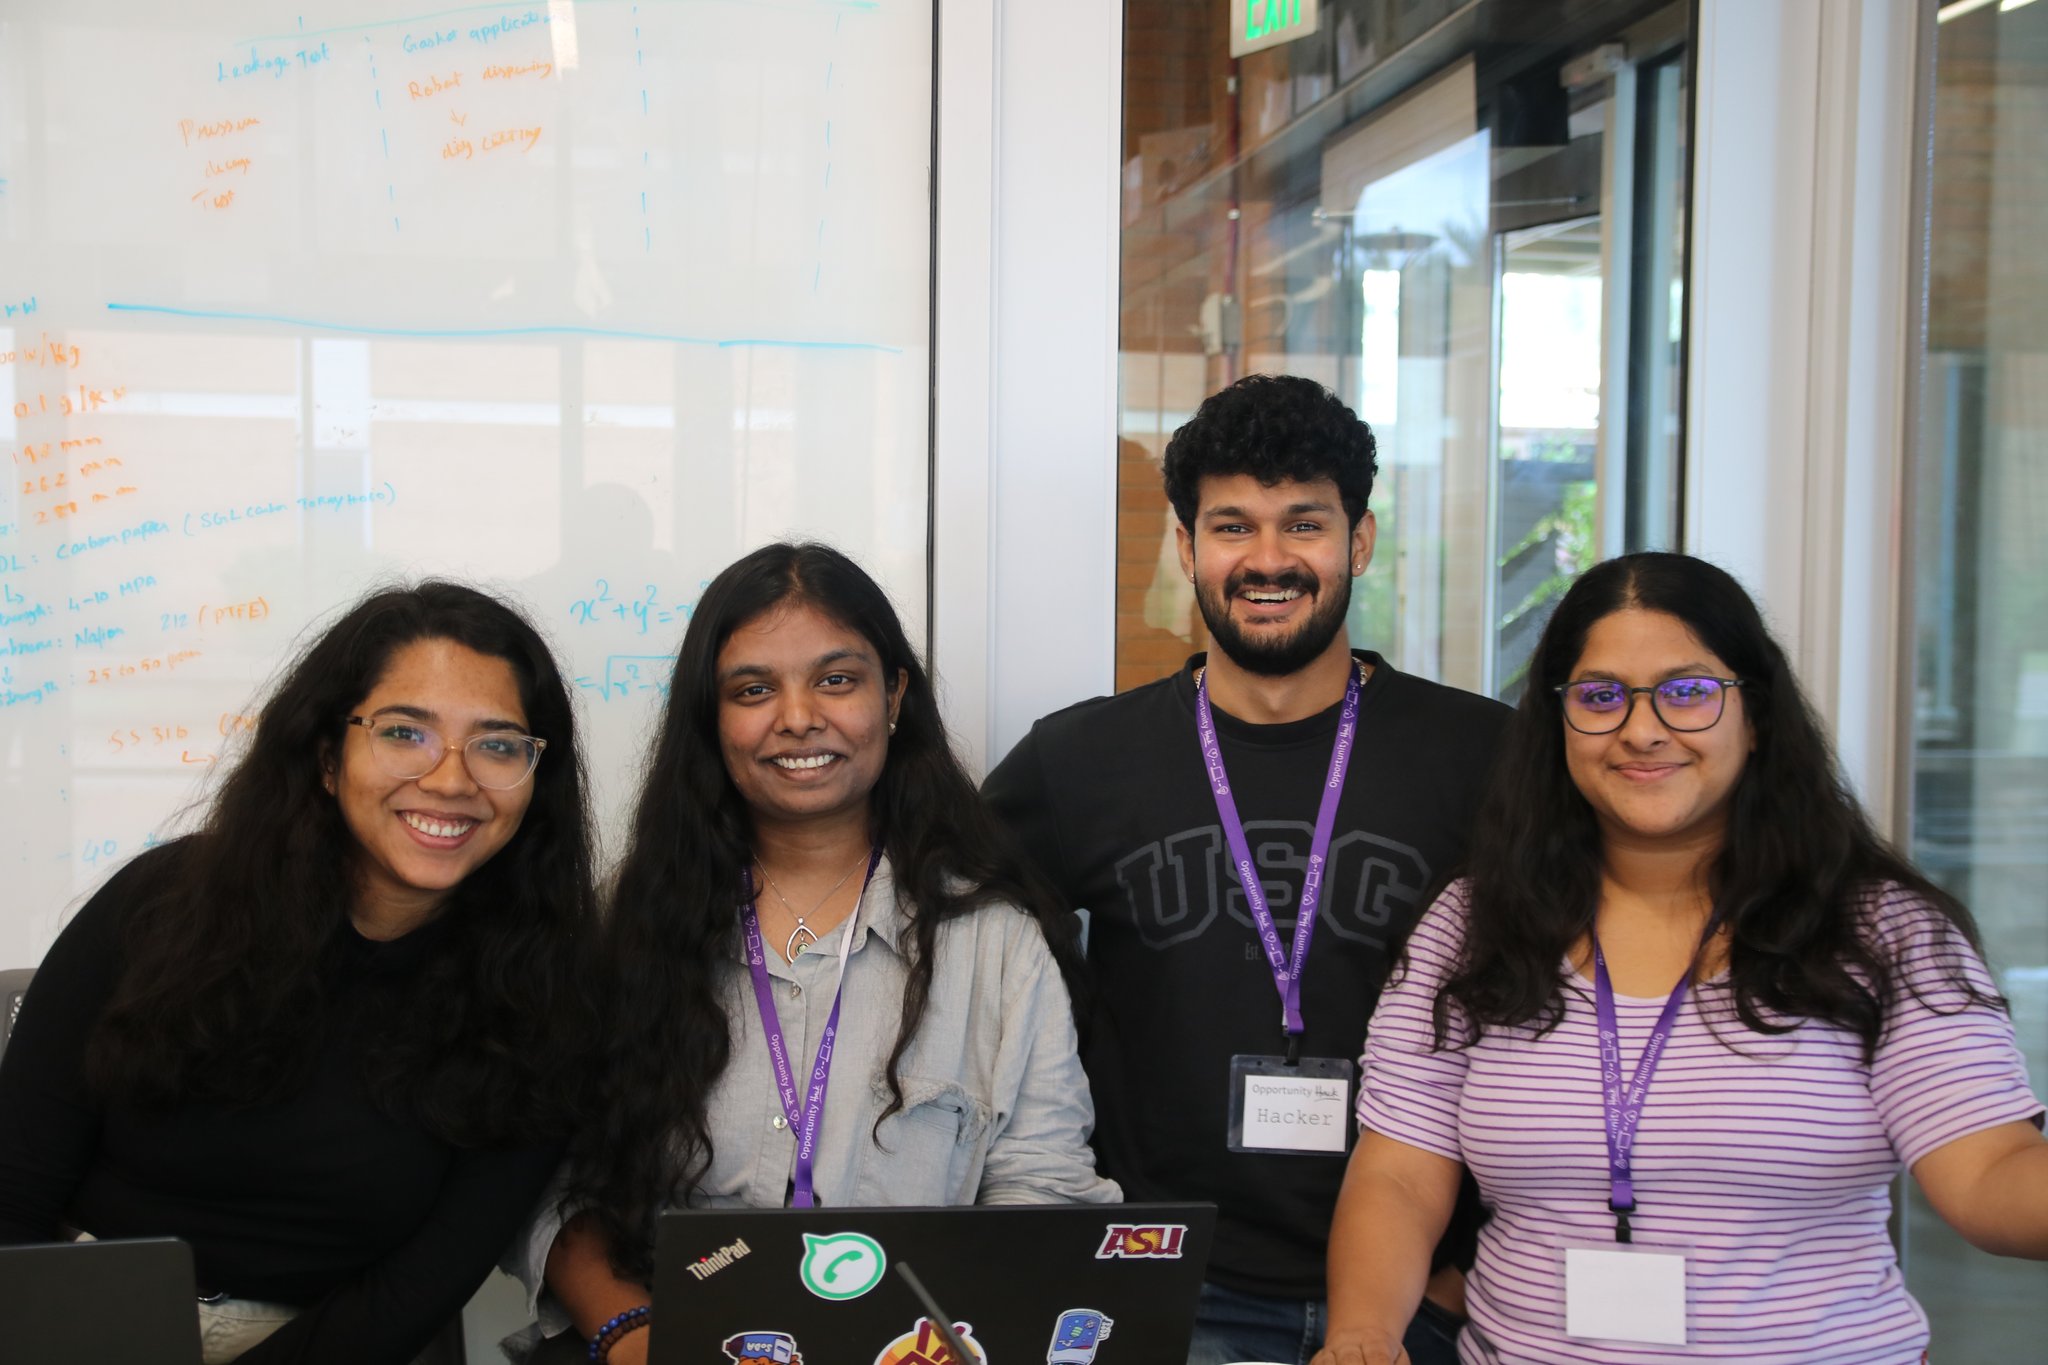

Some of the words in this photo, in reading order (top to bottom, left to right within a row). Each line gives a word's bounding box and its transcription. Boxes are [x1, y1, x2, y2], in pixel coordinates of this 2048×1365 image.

[469, 11, 553, 44] applicatio
[1328, 740, 1350, 788] Opportunity
[1240, 860, 1264, 911] Opportunity
[1290, 927, 1309, 980] Opportunity
[771, 1034, 790, 1088] Opportunity
[1634, 1032, 1665, 1086] Opportunity
[1252, 1083, 1313, 1099] Opportunity
[800, 1103, 820, 1160] Opportunity
[1256, 1107, 1334, 1127] Hacker
[685, 1237, 752, 1281] ThinkPad
[1100, 1226, 1184, 1256] ASU
